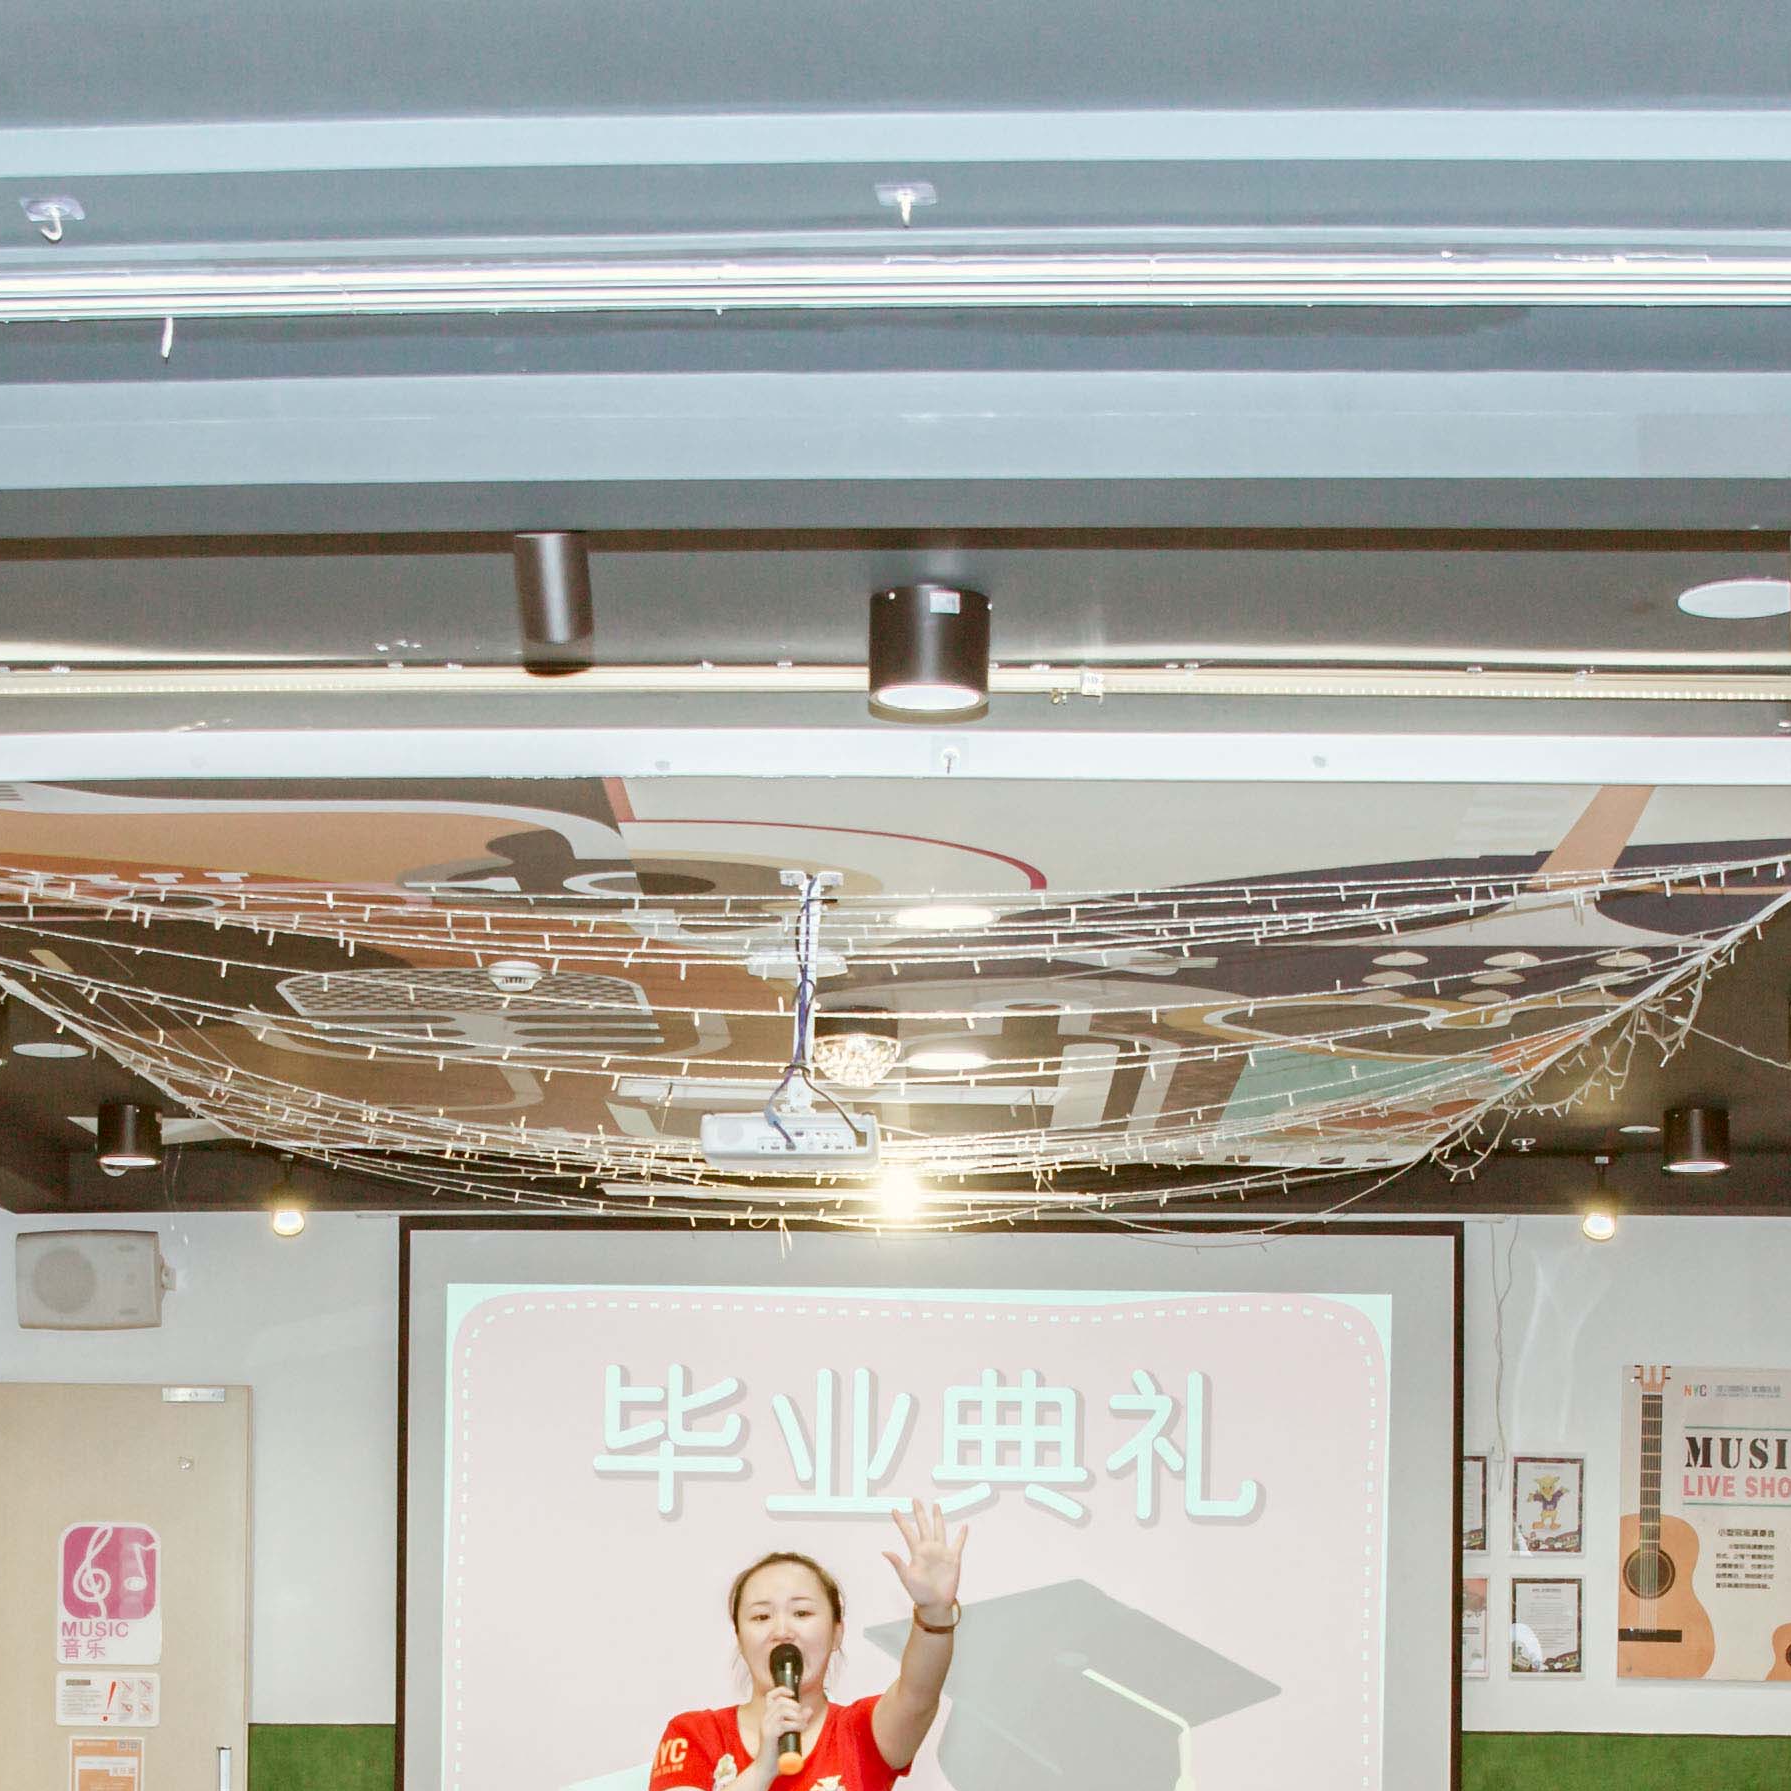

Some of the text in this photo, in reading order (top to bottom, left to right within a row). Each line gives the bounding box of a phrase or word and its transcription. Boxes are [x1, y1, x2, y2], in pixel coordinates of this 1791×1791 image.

[592, 1363, 1261, 1520] 毕业典礼
[1683, 1475, 1735, 1497] LIVE
[61, 1621, 129, 1638] MUSIC
[62, 1638, 106, 1660] 音乐
[653, 1737, 688, 1770] YC
